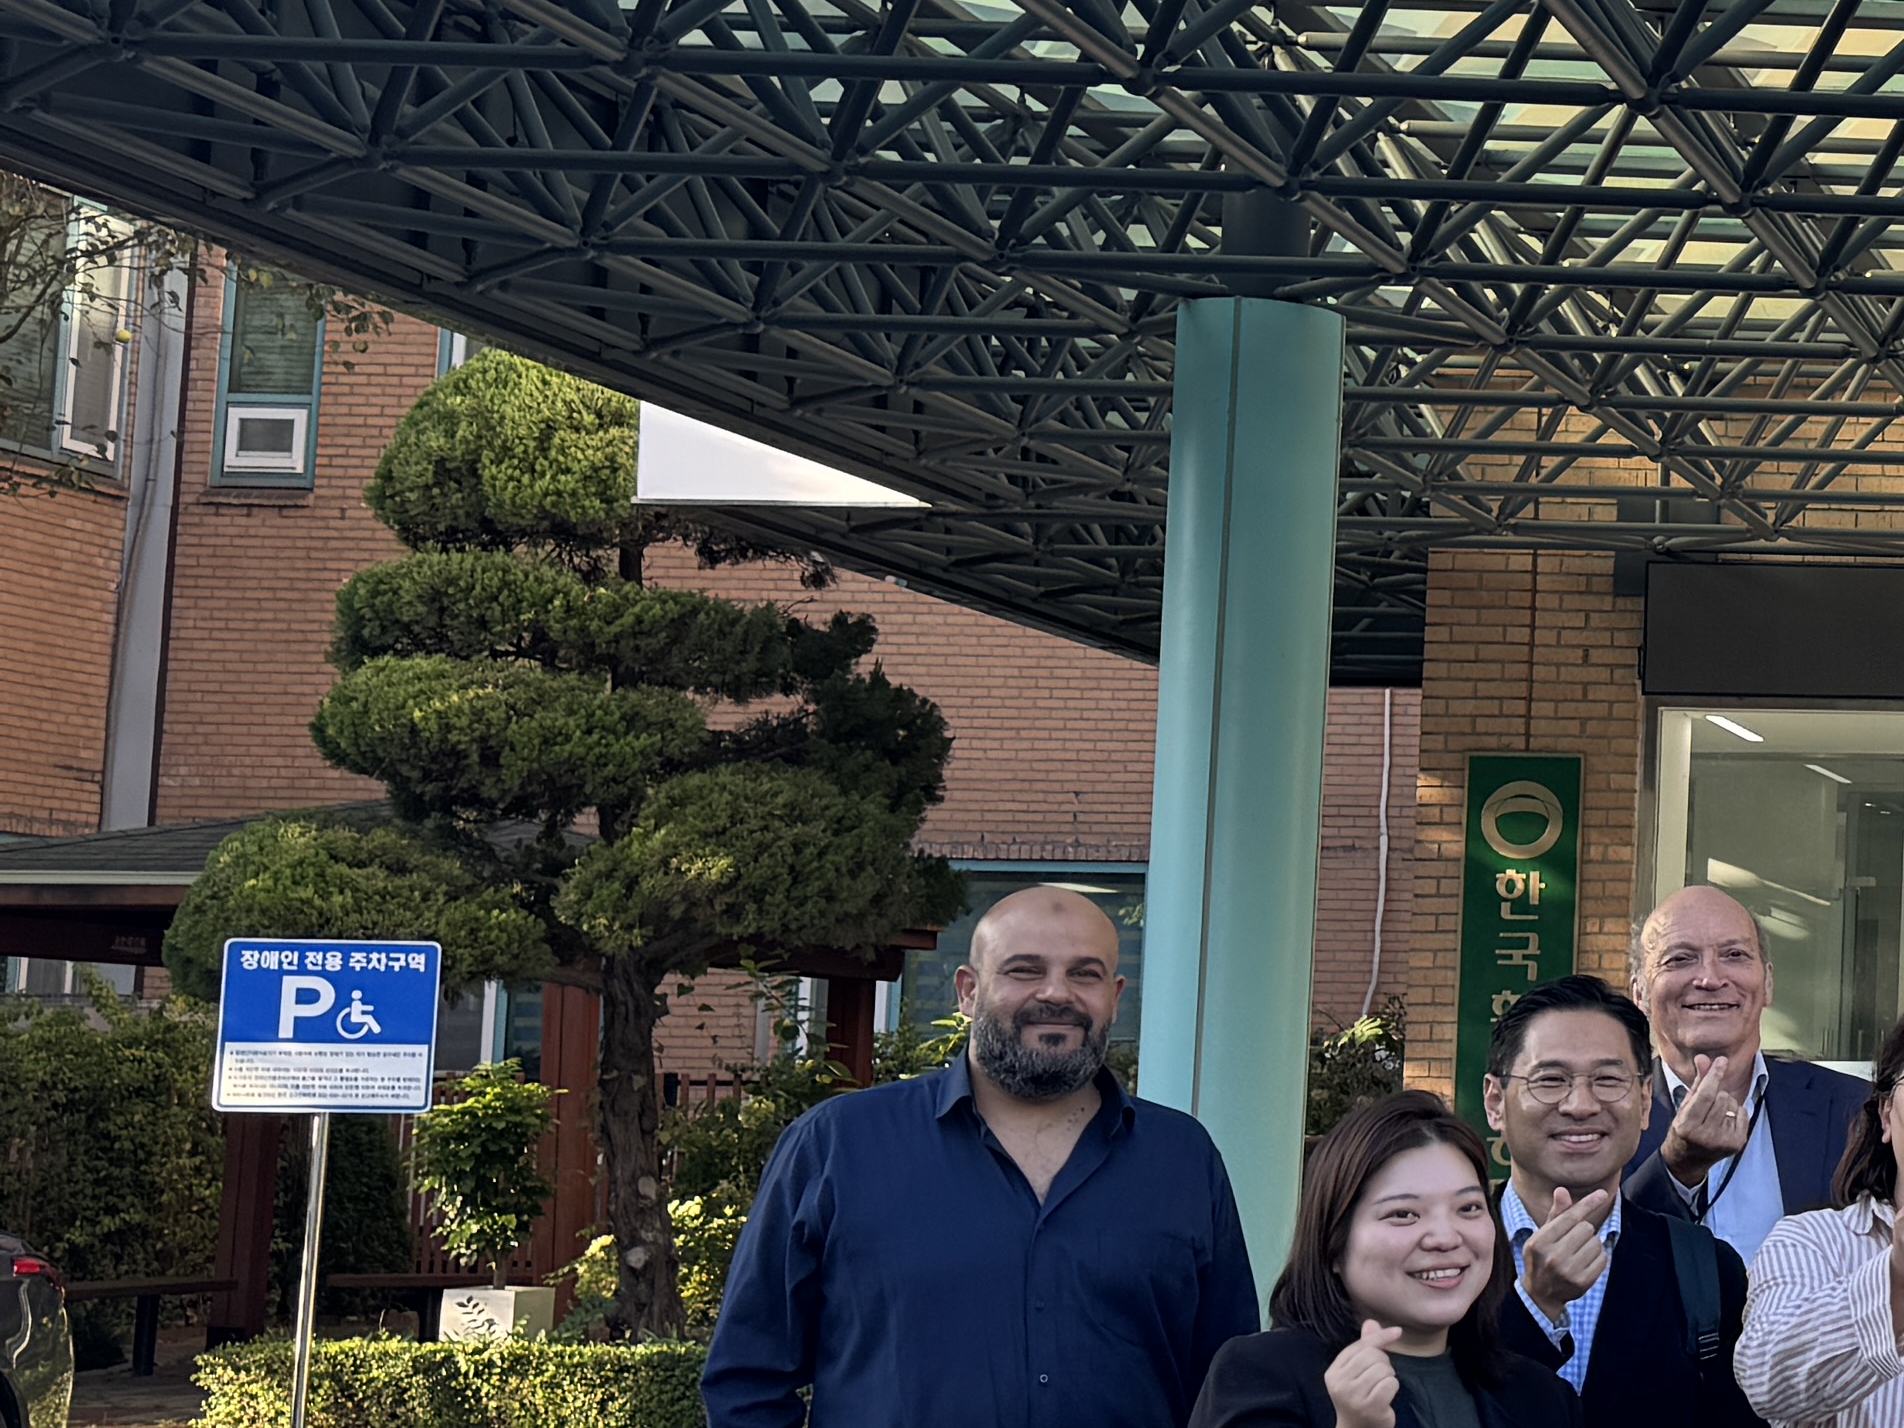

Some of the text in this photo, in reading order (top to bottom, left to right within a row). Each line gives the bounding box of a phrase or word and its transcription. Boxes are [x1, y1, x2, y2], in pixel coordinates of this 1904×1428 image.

[240, 950, 426, 973] 장애인 전용 주차구역
[278, 975, 336, 1039] P
